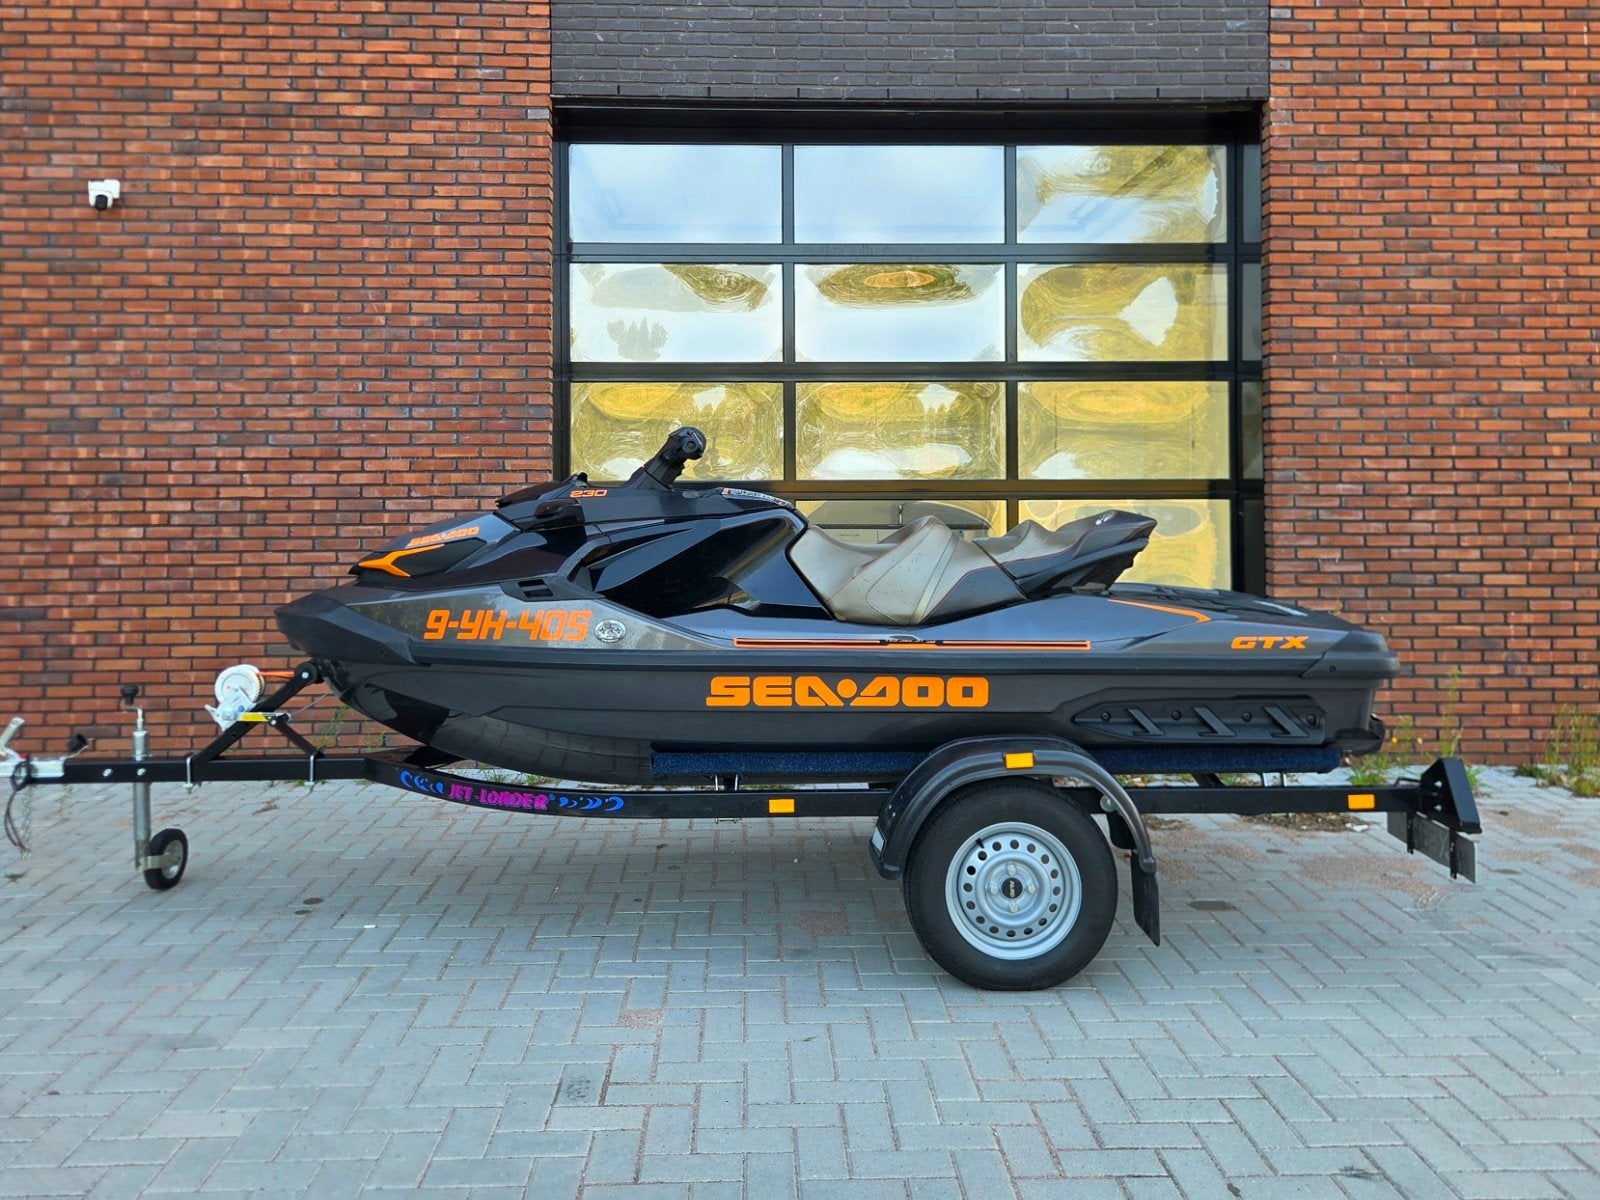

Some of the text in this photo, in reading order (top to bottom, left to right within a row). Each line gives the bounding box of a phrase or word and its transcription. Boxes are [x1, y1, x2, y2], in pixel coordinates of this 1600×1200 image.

[570, 489, 608, 498] 230
[423, 609, 592, 641] 9-YH-405
[1231, 635, 1310, 650] GTX
